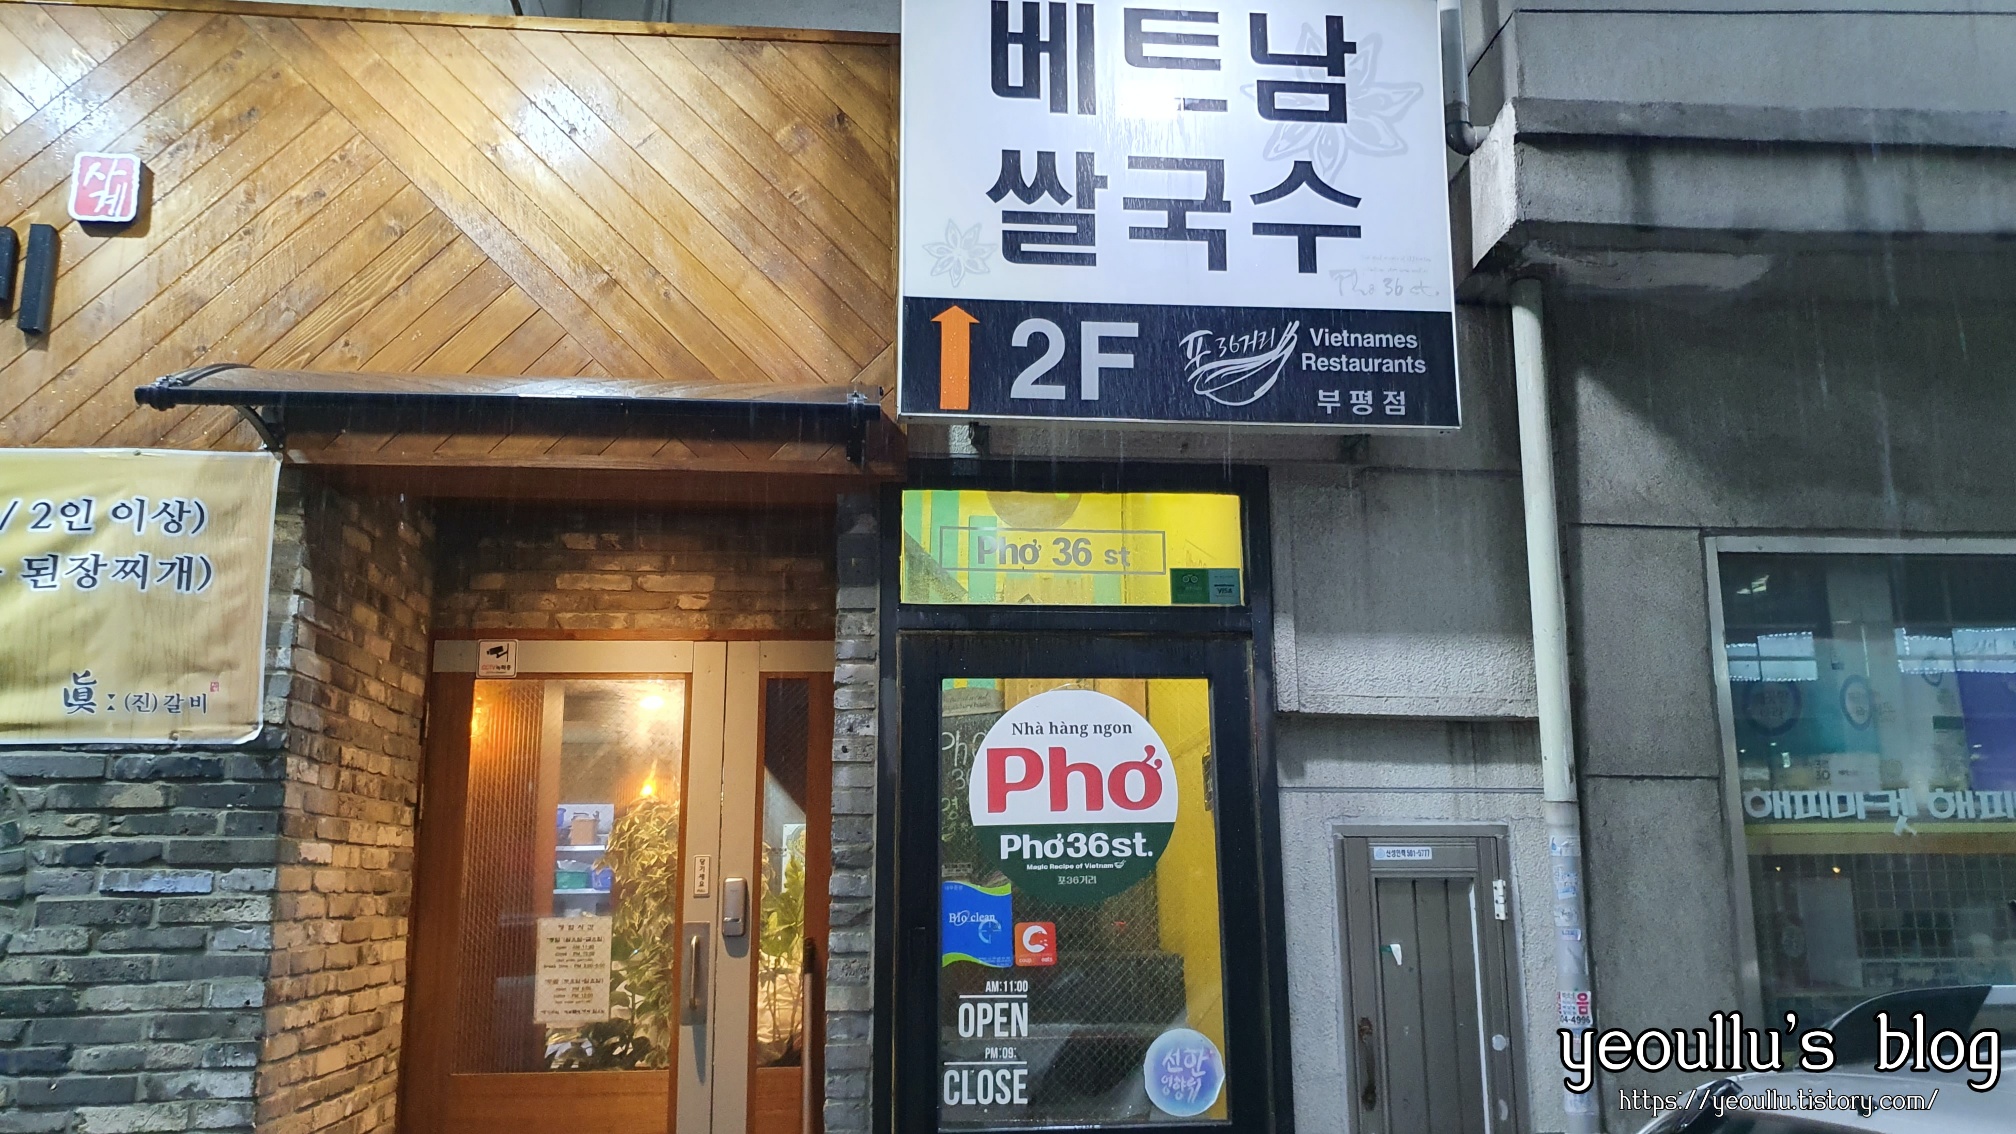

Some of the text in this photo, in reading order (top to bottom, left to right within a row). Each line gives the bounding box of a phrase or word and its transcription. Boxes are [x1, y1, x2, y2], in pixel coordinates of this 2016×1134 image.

[990, 0, 1357, 124] 베트남
[986, 149, 1362, 274] 쌀국수
[1309, 327, 1419, 350] Vietnames
[1009, 317, 1140, 402] 2F
[1301, 352, 1427, 375] Restaurants
[1316, 389, 1407, 416] 부평점
[111, 498, 206, 534] 이상)
[977, 533, 1131, 568] Phở 36 st
[20, 553, 213, 592] 된장찌개)
[1011, 721, 1133, 738] Nhà hàng ngon
[986, 744, 1163, 814] Phở
[1026, 863, 1048, 871] Magic
[1049, 862, 1074, 870] Recipe
[1084, 861, 1114, 869] Vietnam
[970, 911, 996, 923] clean
[985, 980, 1029, 993] AM:11:00
[958, 1002, 1029, 1038] OPEN
[1162, 1045, 1210, 1078] 선한
[943, 1068, 1029, 1106] CLOSE
